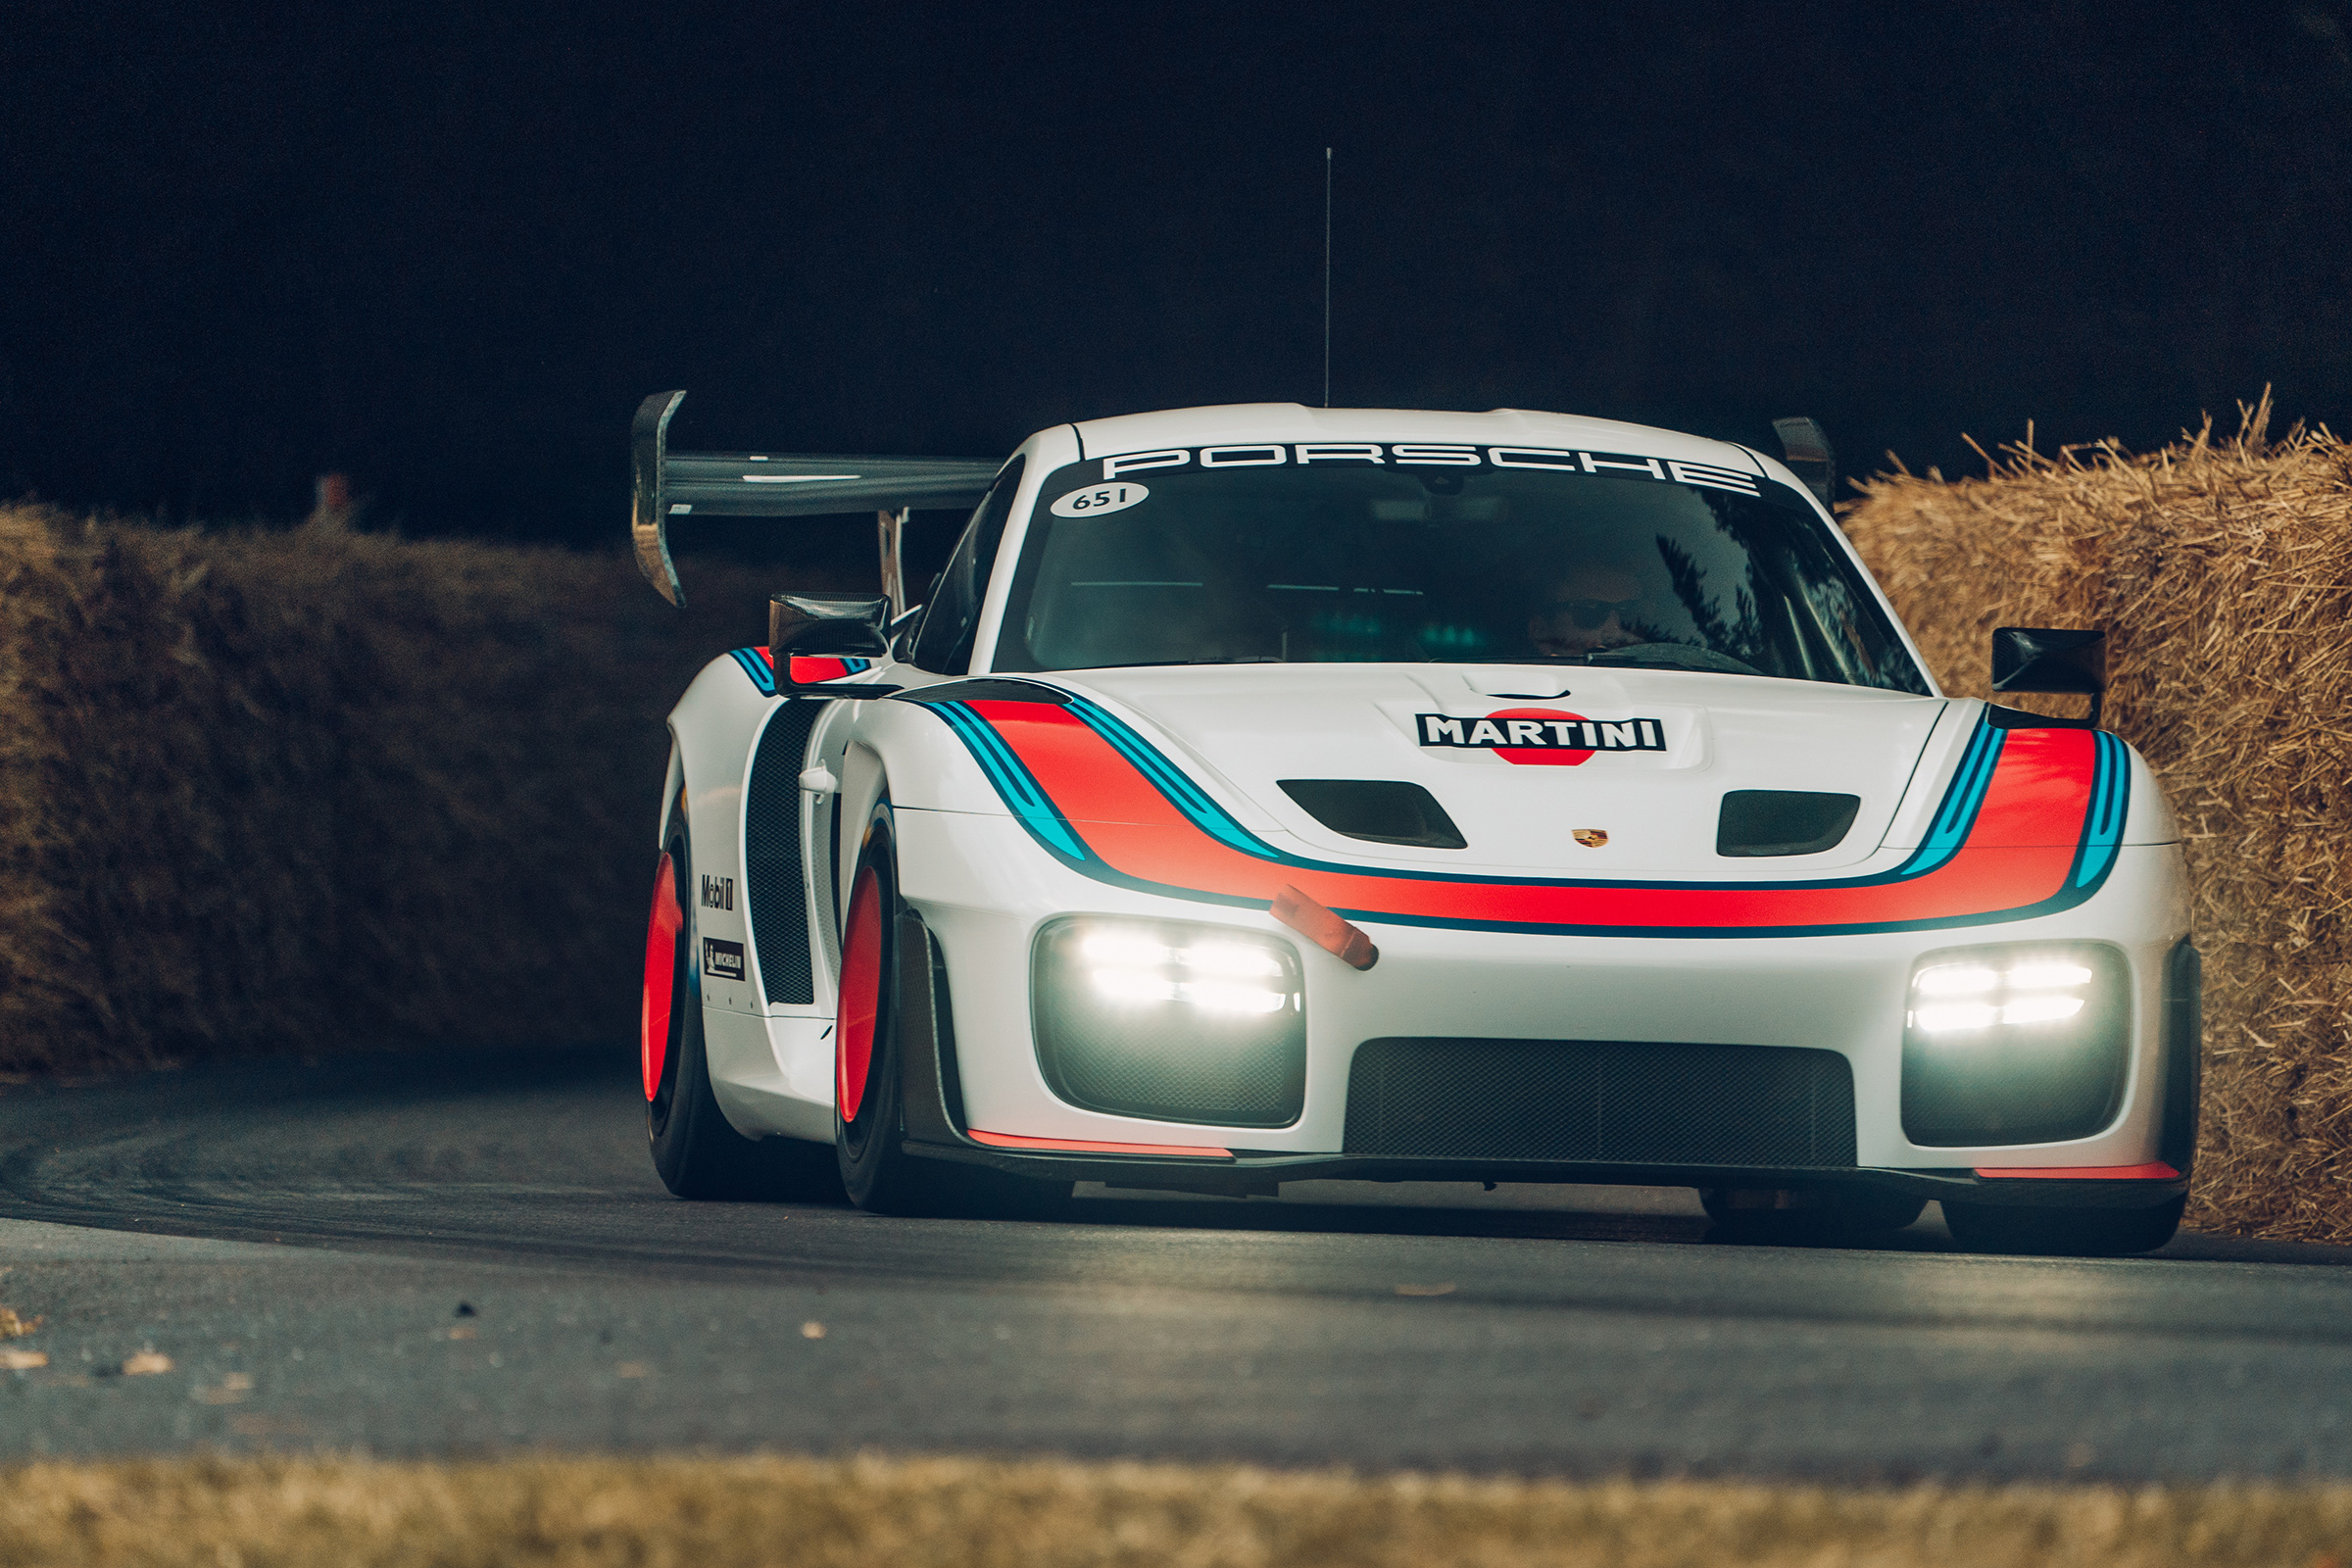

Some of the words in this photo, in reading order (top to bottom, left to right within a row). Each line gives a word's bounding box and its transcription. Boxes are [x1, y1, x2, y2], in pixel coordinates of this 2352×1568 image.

[1102, 444, 1761, 497] PORSCHE
[1072, 487, 1127, 512] 651
[1425, 716, 1658, 748] MARTINI
[701, 874, 725, 909] Mobil
[725, 878, 733, 910] 1
[714, 952, 742, 969] MICHELIN
